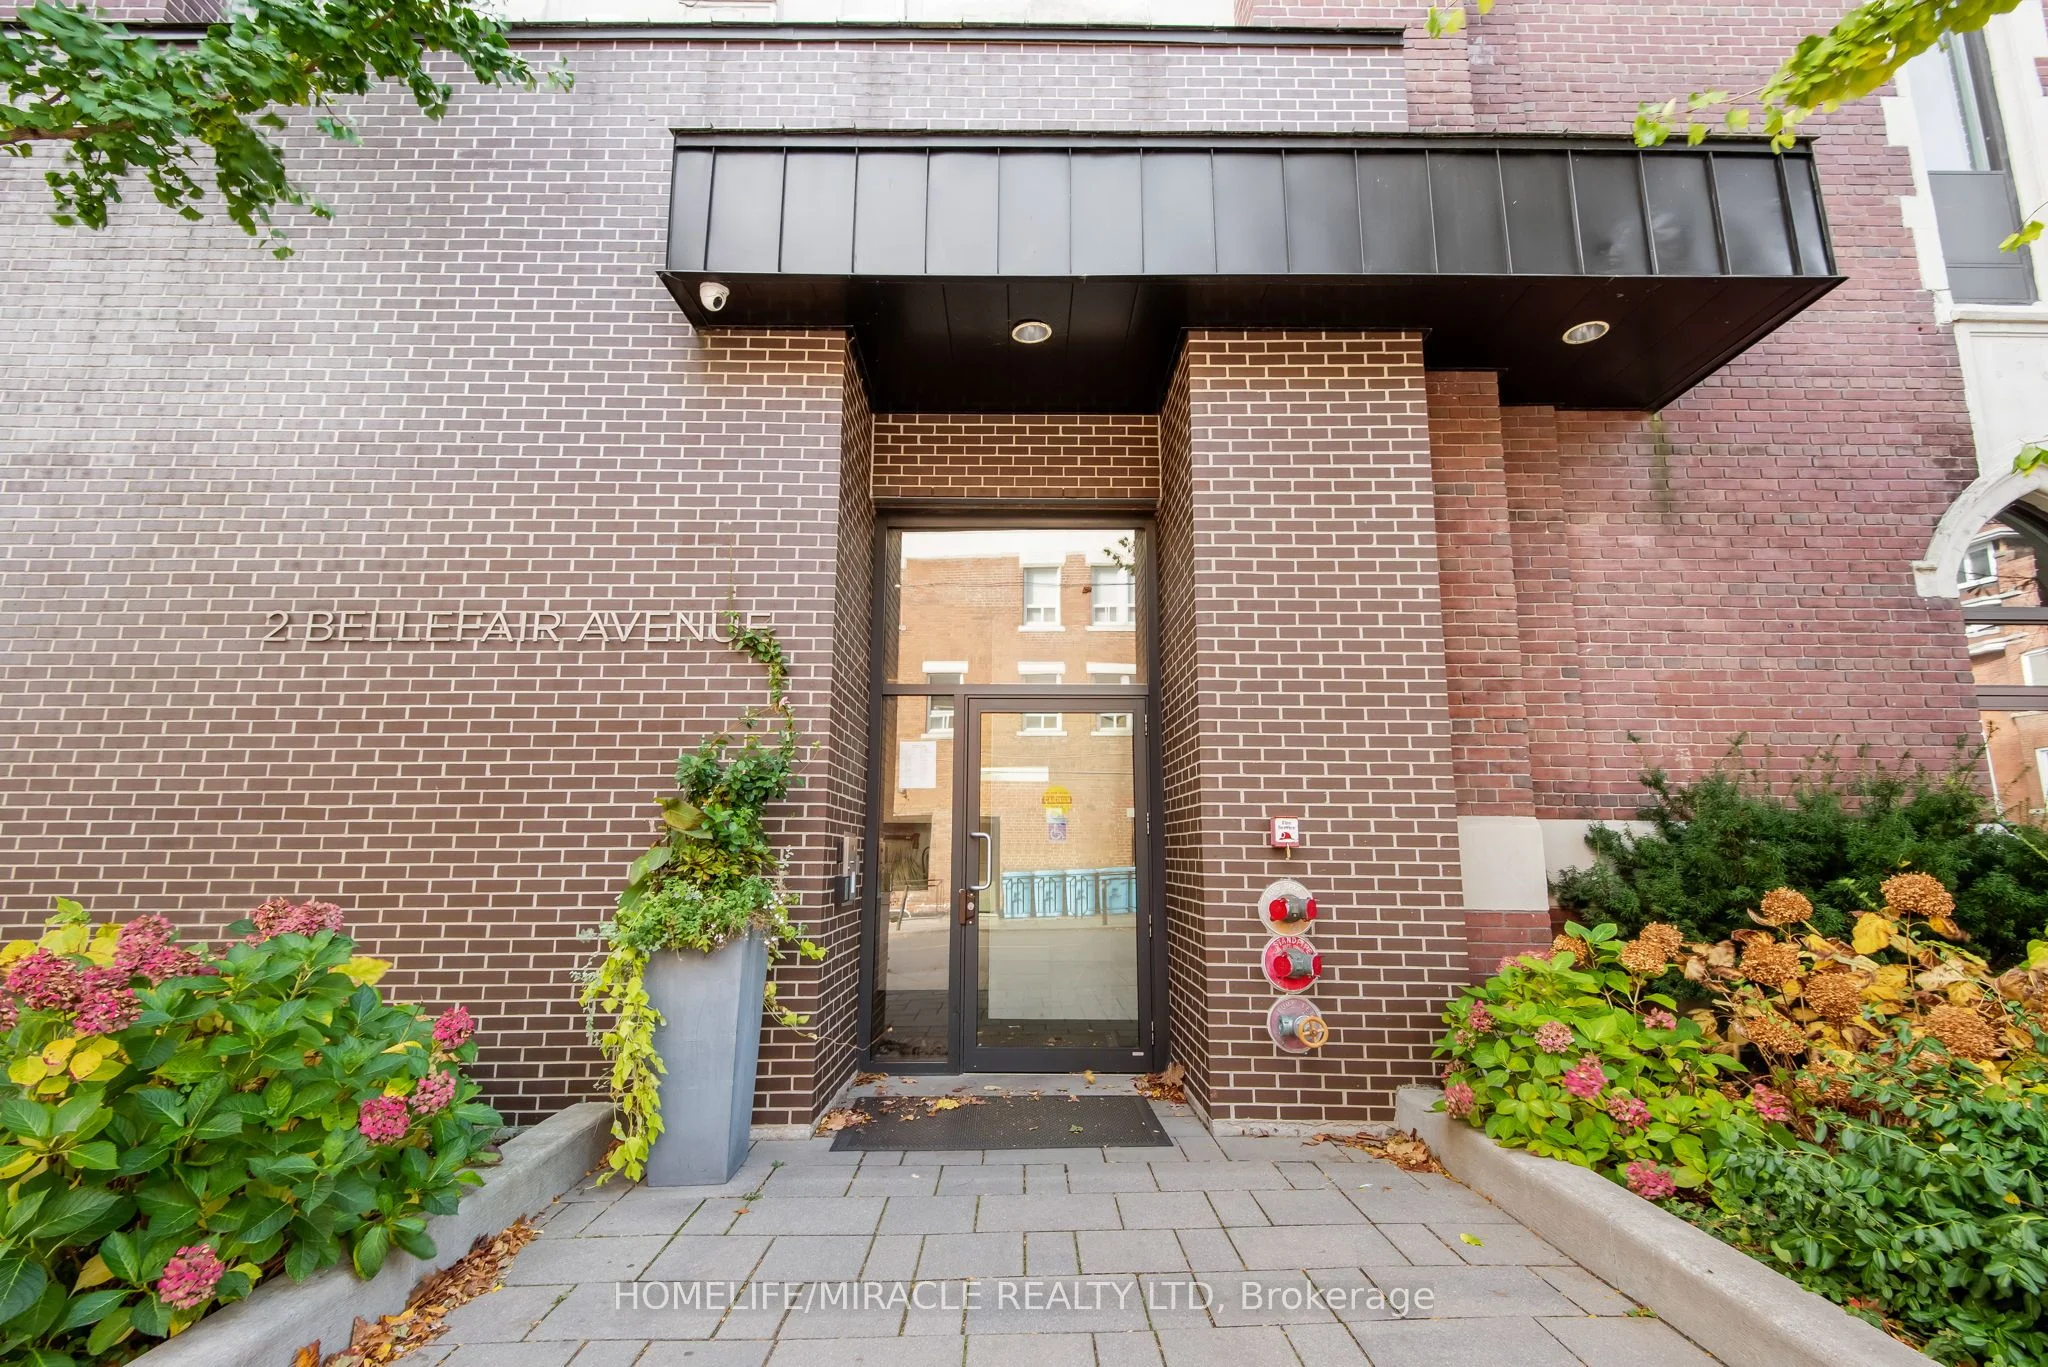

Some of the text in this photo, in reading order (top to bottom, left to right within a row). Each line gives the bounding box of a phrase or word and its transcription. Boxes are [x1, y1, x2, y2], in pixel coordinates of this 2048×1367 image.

[263, 609, 771, 643] 2 BELLEFAIR AVENUE
